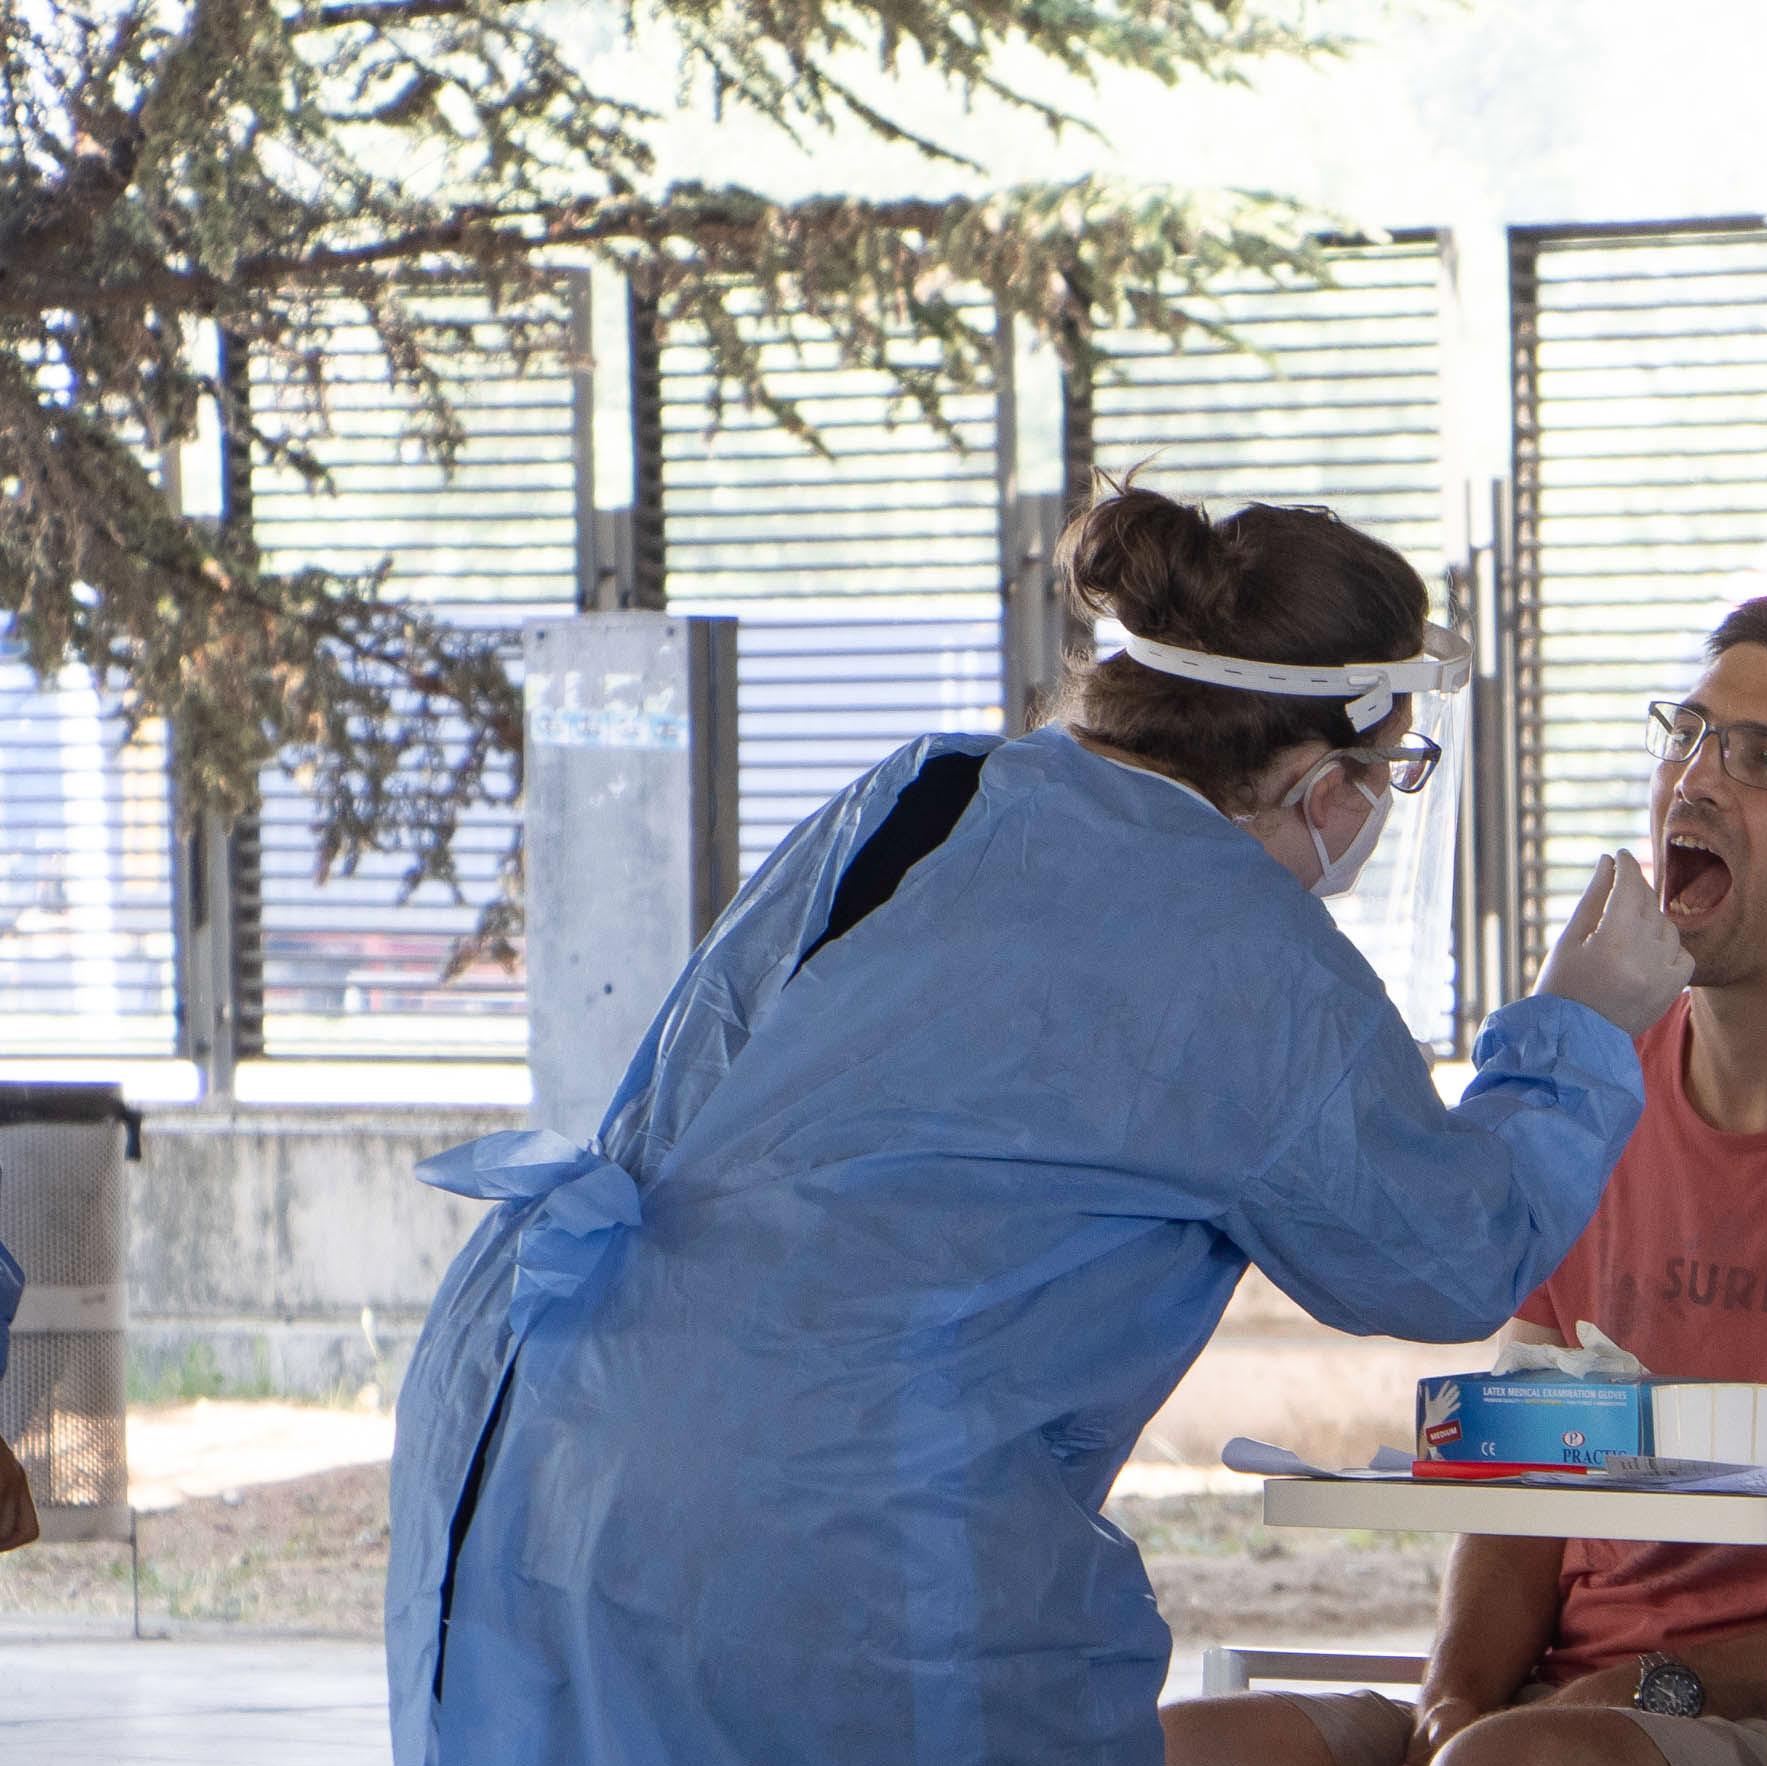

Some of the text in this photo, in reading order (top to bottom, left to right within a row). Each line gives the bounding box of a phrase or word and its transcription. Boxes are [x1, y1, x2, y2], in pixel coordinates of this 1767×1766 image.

[1483, 1386, 1627, 1400] LATEX MEDICAL EXAMINATION GLOVES
[1481, 1441, 1496, 1457] CE
